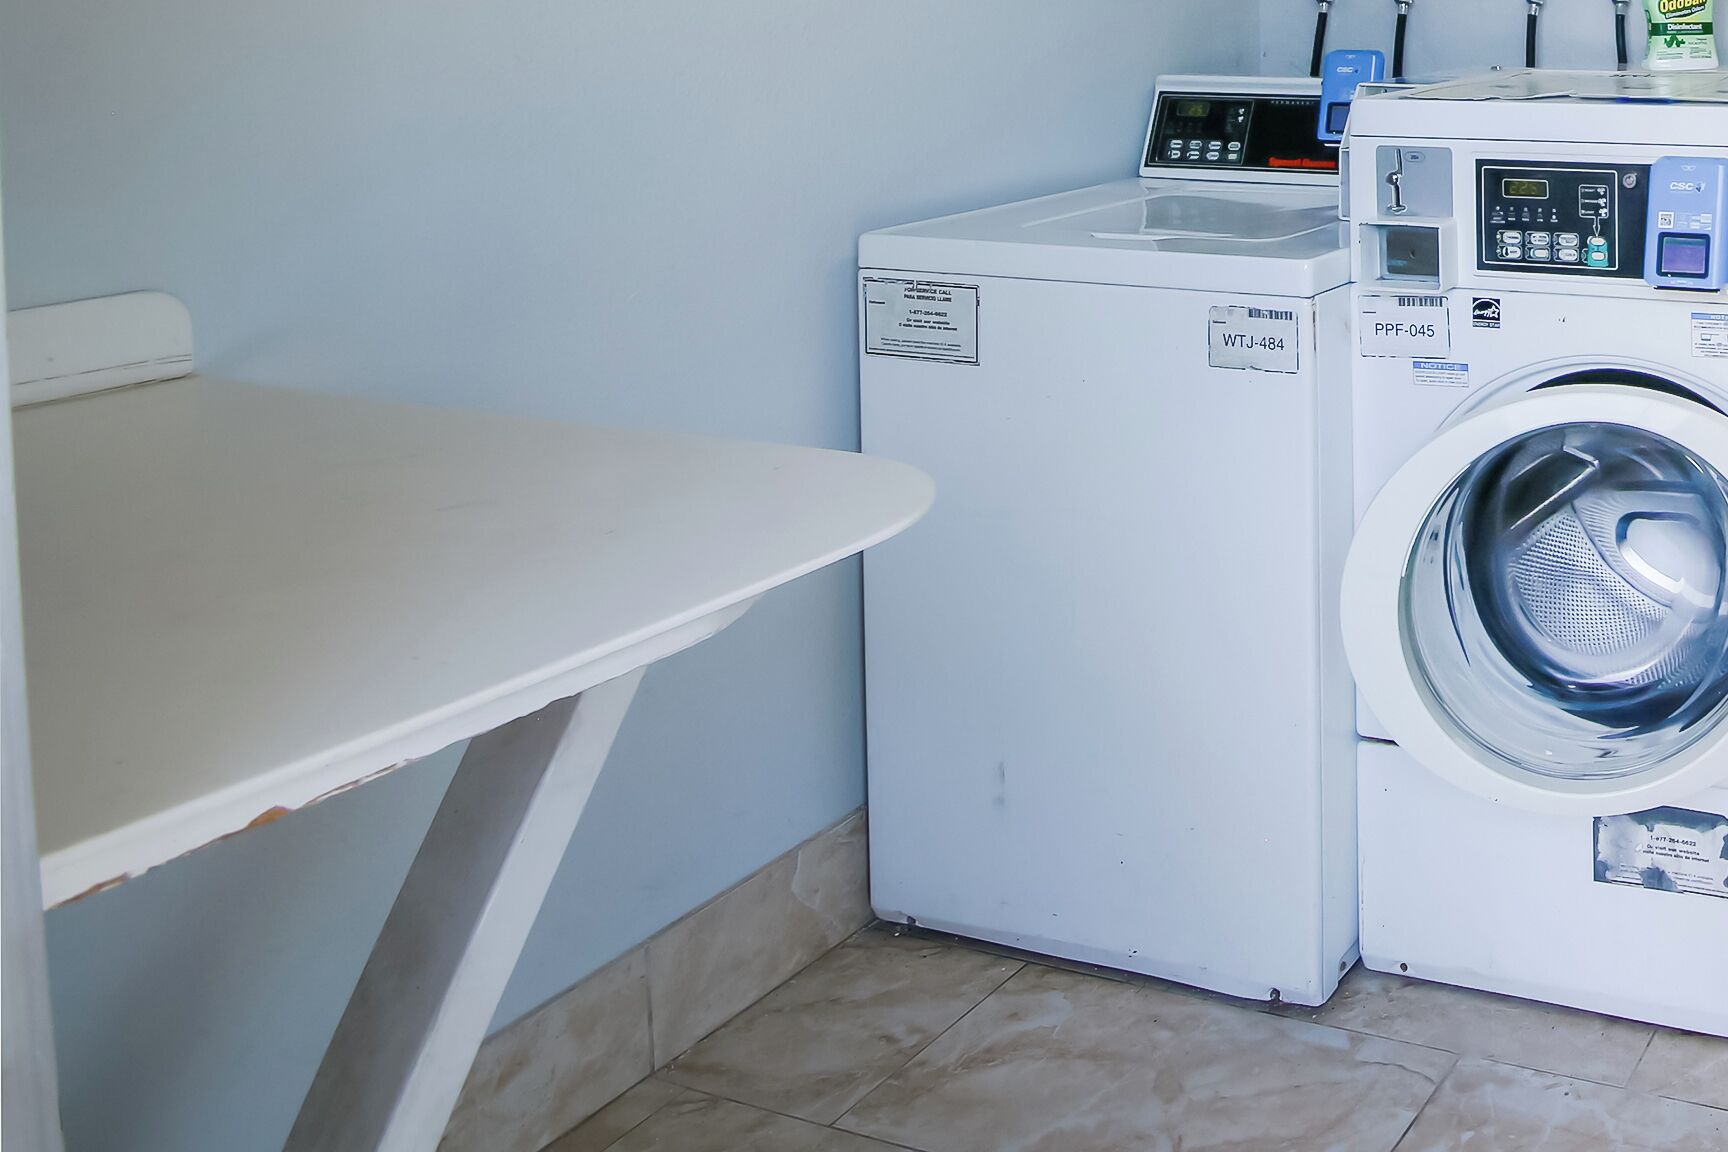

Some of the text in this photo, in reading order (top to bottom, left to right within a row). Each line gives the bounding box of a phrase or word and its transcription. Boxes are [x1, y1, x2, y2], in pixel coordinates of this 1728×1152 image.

[1669, 181, 1694, 190] CSC
[1375, 322, 1435, 337] PPF-045
[1222, 333, 1285, 351] WTJ-484
